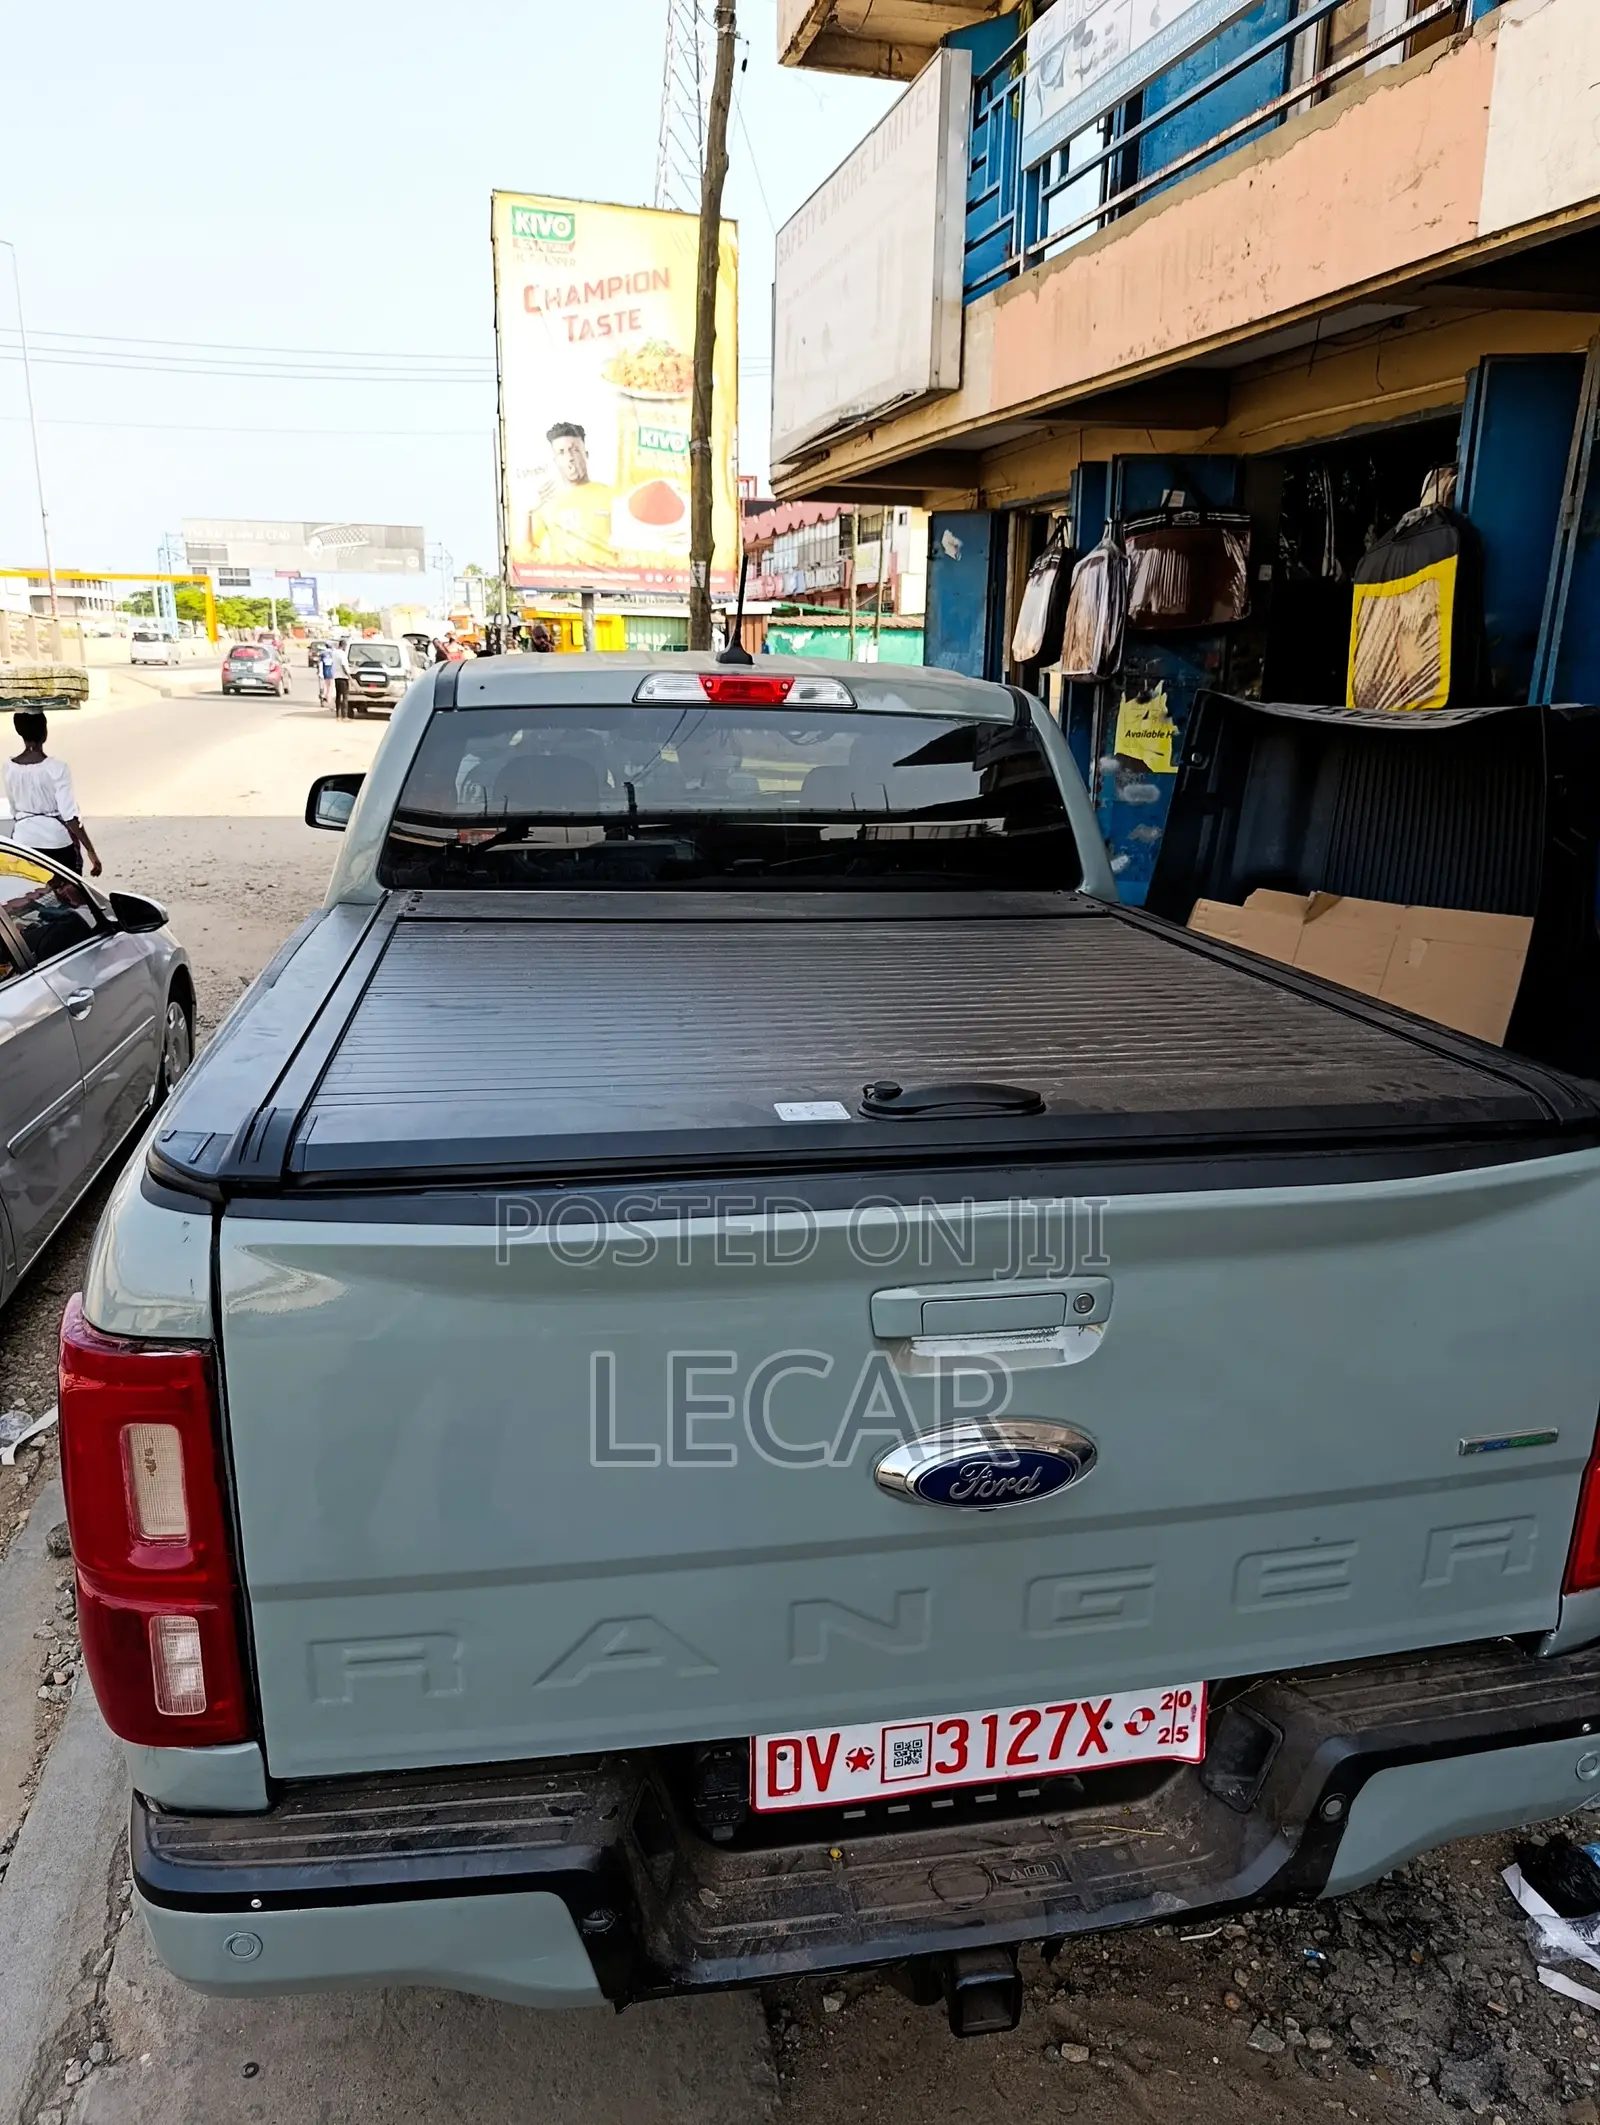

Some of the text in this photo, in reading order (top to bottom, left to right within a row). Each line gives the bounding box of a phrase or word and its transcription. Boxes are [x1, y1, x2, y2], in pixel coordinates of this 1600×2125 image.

[778, 207, 817, 267] SAFETY
[820, 196, 828, 226] &
[831, 149, 868, 215] MORE
[873, 73, 939, 173] LIMITED
[514, 210, 571, 238] KIVO
[562, 308, 643, 343] TASTE
[641, 428, 686, 453] KIVO
[1125, 729, 1164, 739] Available
[949, 1459, 1044, 1501] Ford
[308, 1514, 1538, 1705] RANGER
[767, 1697, 1112, 1798] DV 3127X
